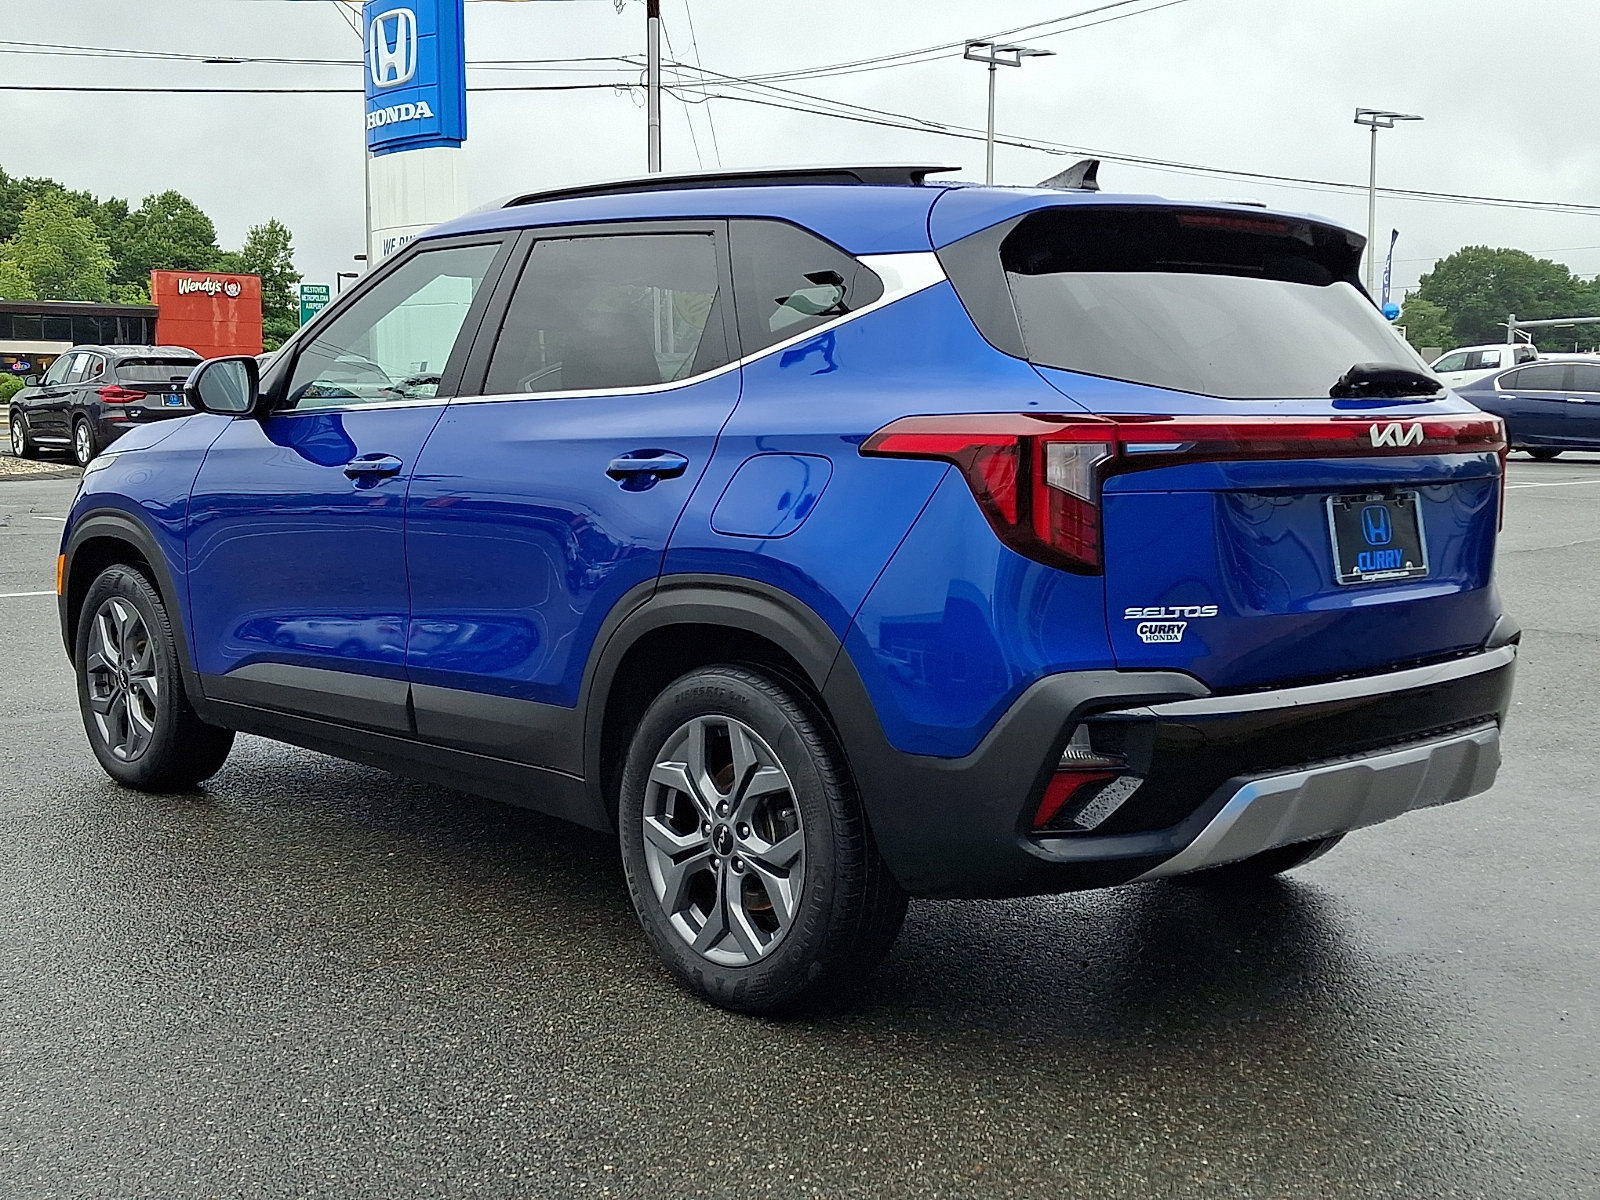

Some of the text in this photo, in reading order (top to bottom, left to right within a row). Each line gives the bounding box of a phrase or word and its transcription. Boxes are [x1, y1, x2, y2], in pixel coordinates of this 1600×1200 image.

[366, 101, 435, 130] HONDA
[178, 277, 222, 296] Wendy's
[1369, 422, 1424, 447] KIA
[1358, 549, 1403, 571] CURRY
[1124, 605, 1218, 619] SELTOS
[1139, 624, 1184, 634] CURRY
